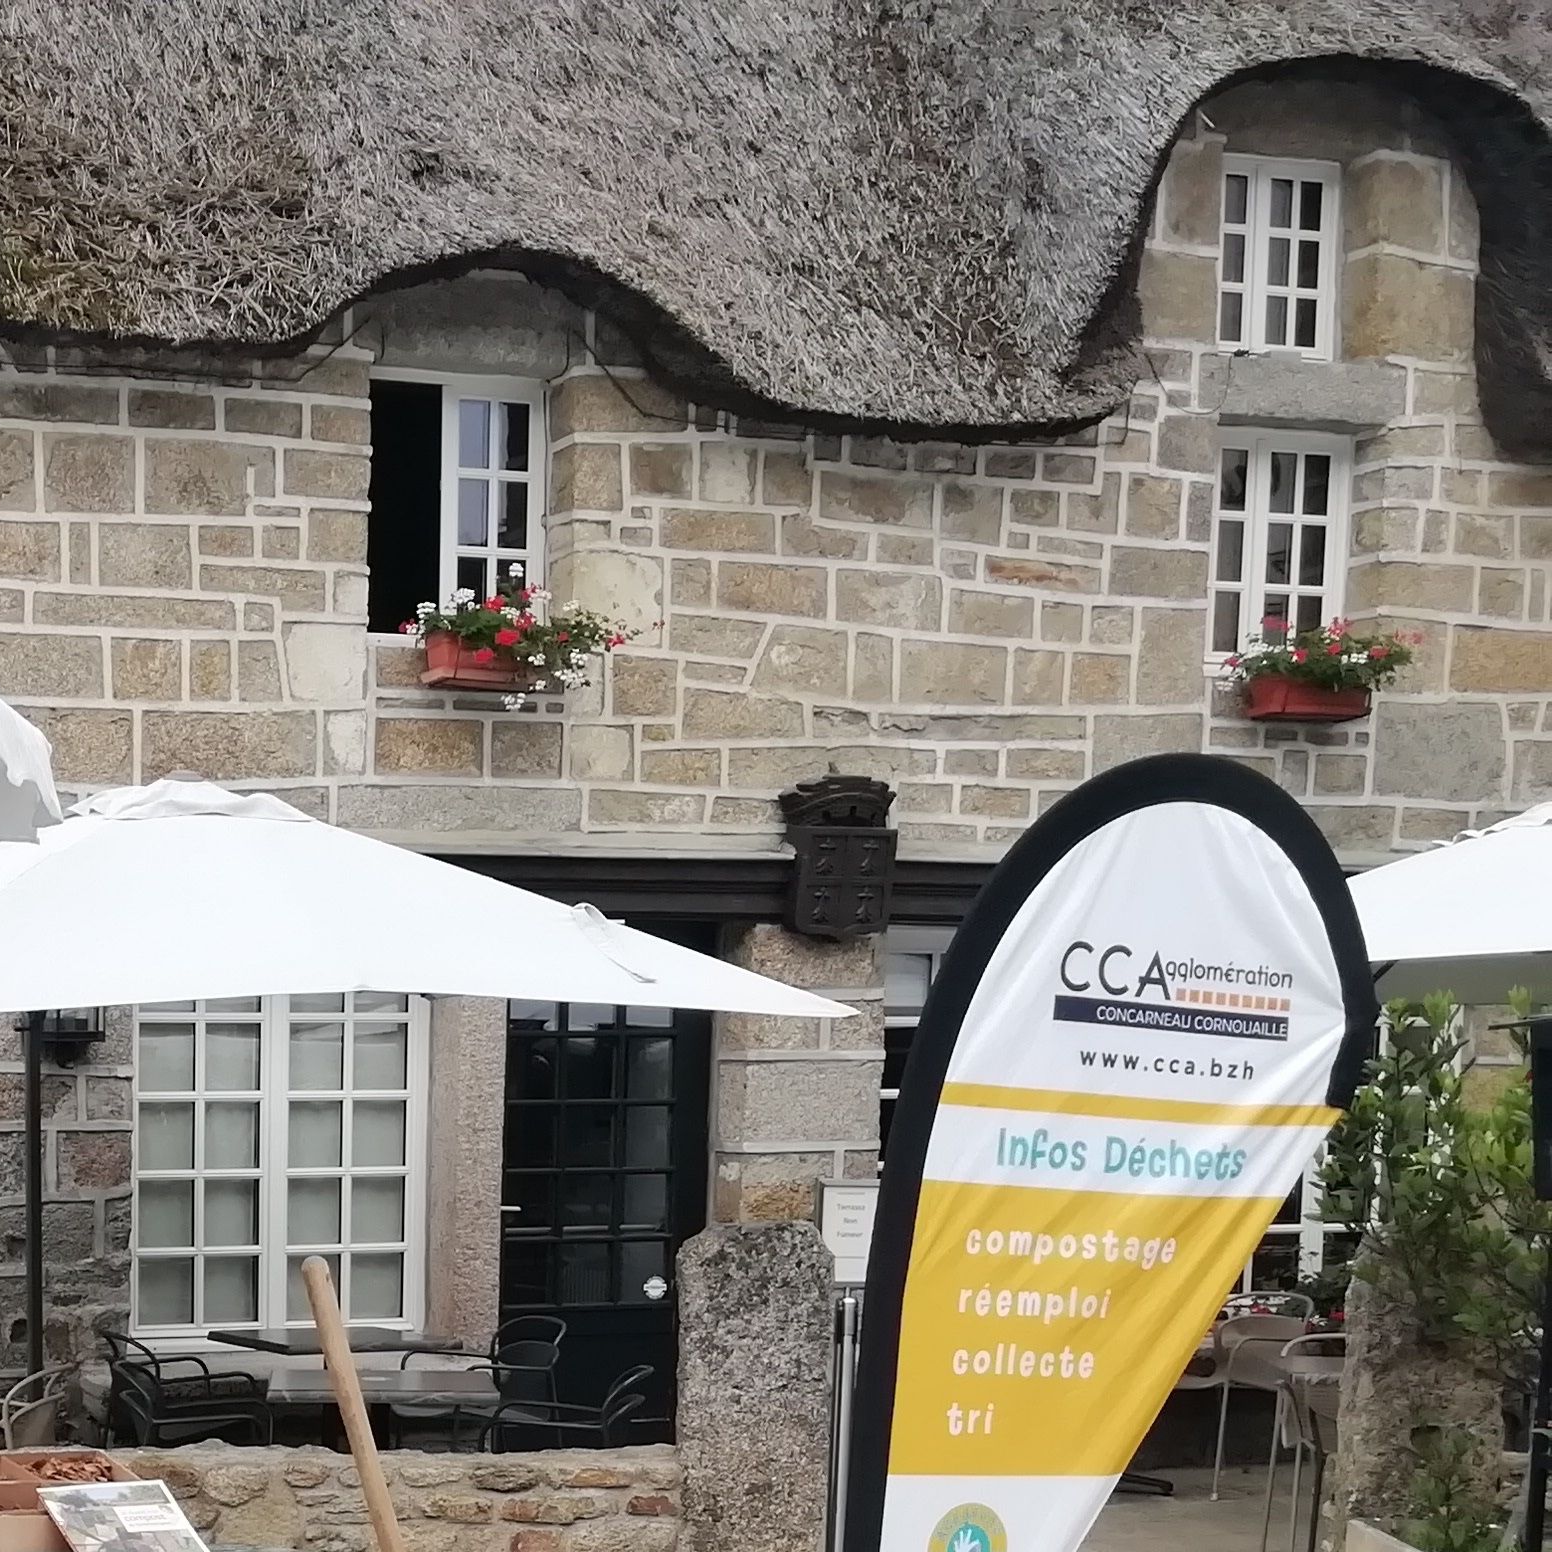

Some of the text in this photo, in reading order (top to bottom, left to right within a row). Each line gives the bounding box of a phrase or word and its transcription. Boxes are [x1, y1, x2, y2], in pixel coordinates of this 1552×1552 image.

[1096, 1005, 1288, 1038] CONCARNEAU CORNOUAILLE
[1080, 1050, 1255, 1081] www.cca.bzh
[996, 1127, 1248, 1182] Infos Déchets
[966, 1228, 1177, 1270] compostage
[958, 1283, 1112, 1325] réemploi
[952, 1343, 1096, 1379] collecte
[946, 1402, 995, 1436] tri
